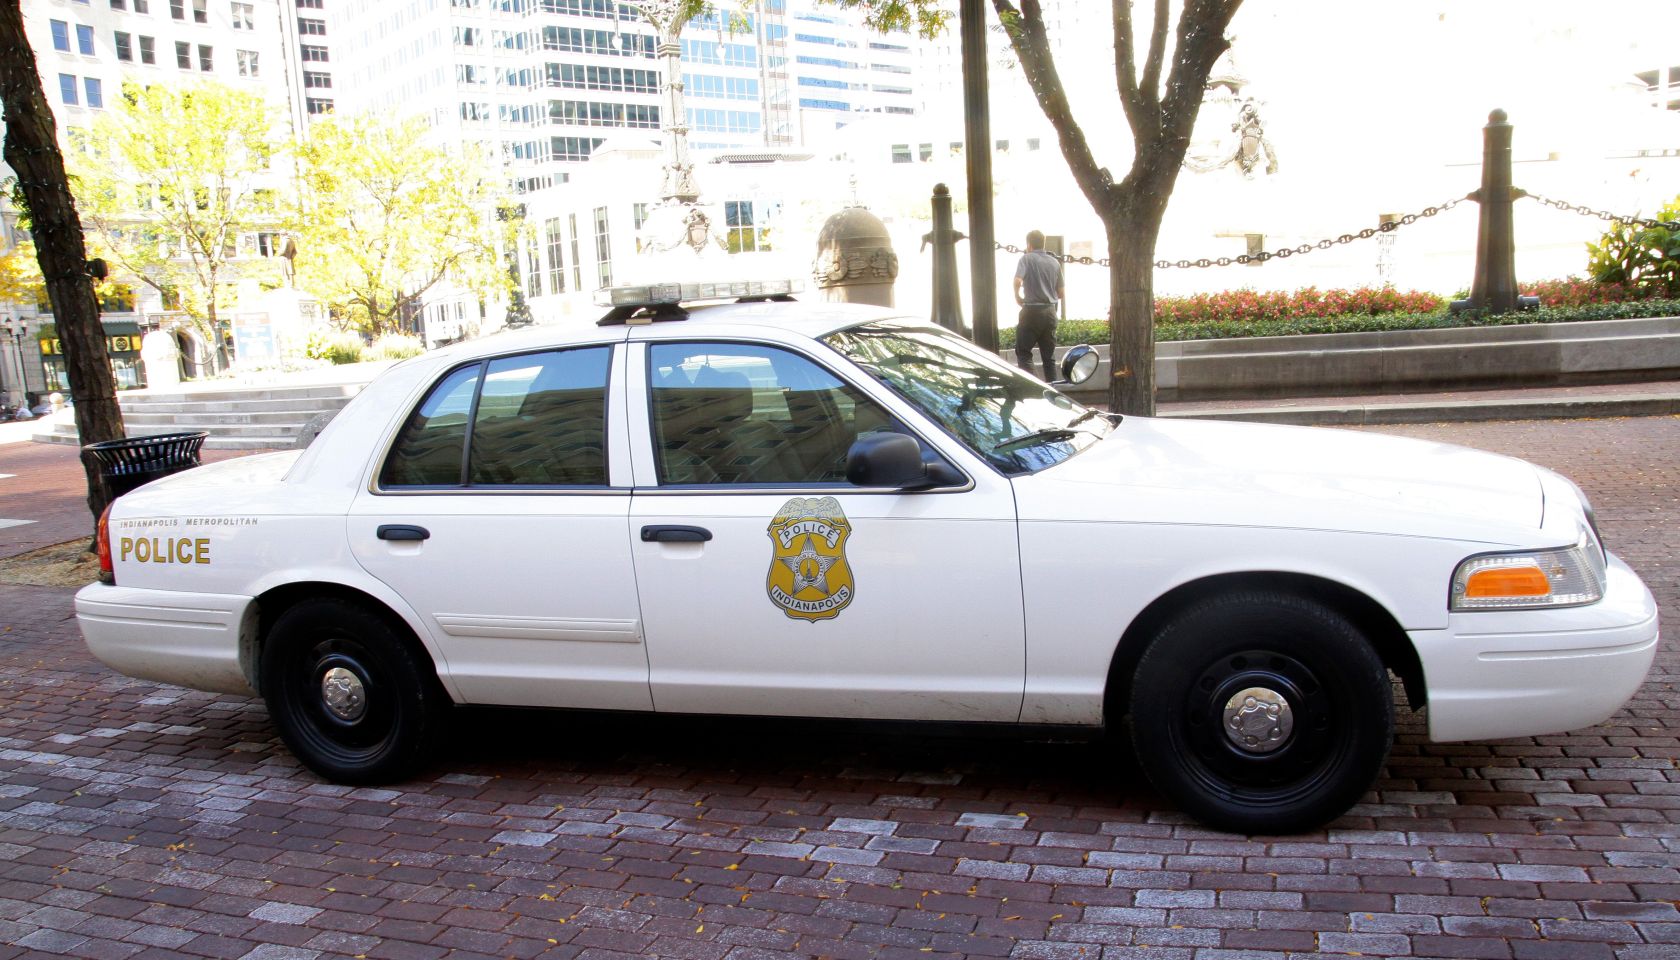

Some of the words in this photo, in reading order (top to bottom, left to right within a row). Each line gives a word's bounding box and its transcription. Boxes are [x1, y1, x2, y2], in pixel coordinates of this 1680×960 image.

[120, 520, 178, 529] INDIANAPOLIS
[185, 518, 258, 526] METROPOLITAN
[783, 523, 835, 540] POLICE
[120, 537, 210, 565] POLICE
[772, 588, 849, 611] INDIANAPOLIS
